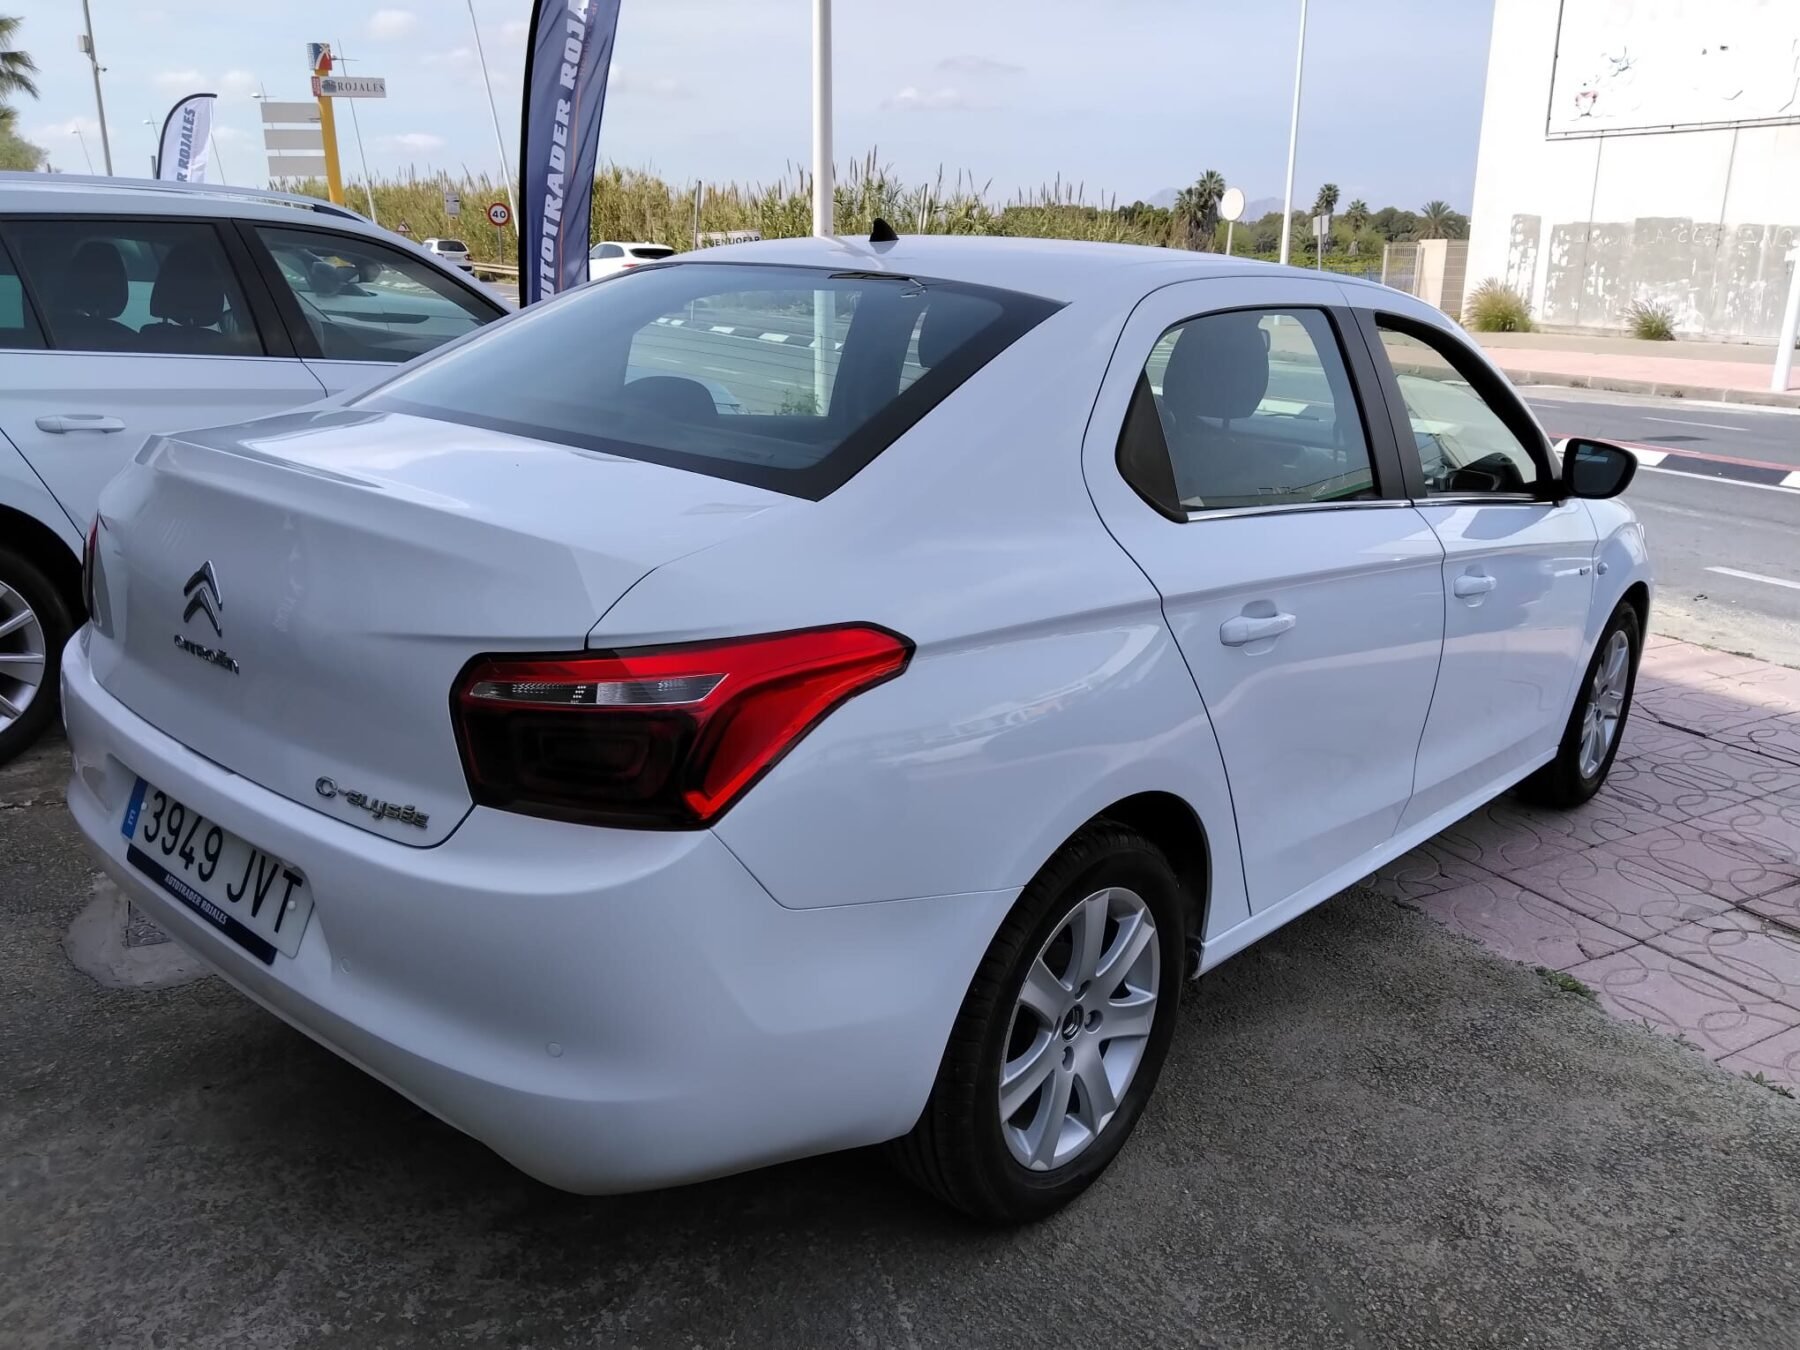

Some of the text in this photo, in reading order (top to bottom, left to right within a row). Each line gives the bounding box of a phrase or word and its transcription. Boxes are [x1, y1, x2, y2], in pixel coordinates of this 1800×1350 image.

[337, 81, 385, 93] ROJALES
[177, 106, 196, 171] ROJALES
[540, 98, 571, 301] UTOTRADER
[560, 0, 590, 90] ROJA
[492, 210, 507, 219] 40
[144, 790, 304, 934] 3949 JVT
[164, 873, 229, 925] AUTOTRADER ROJALES
